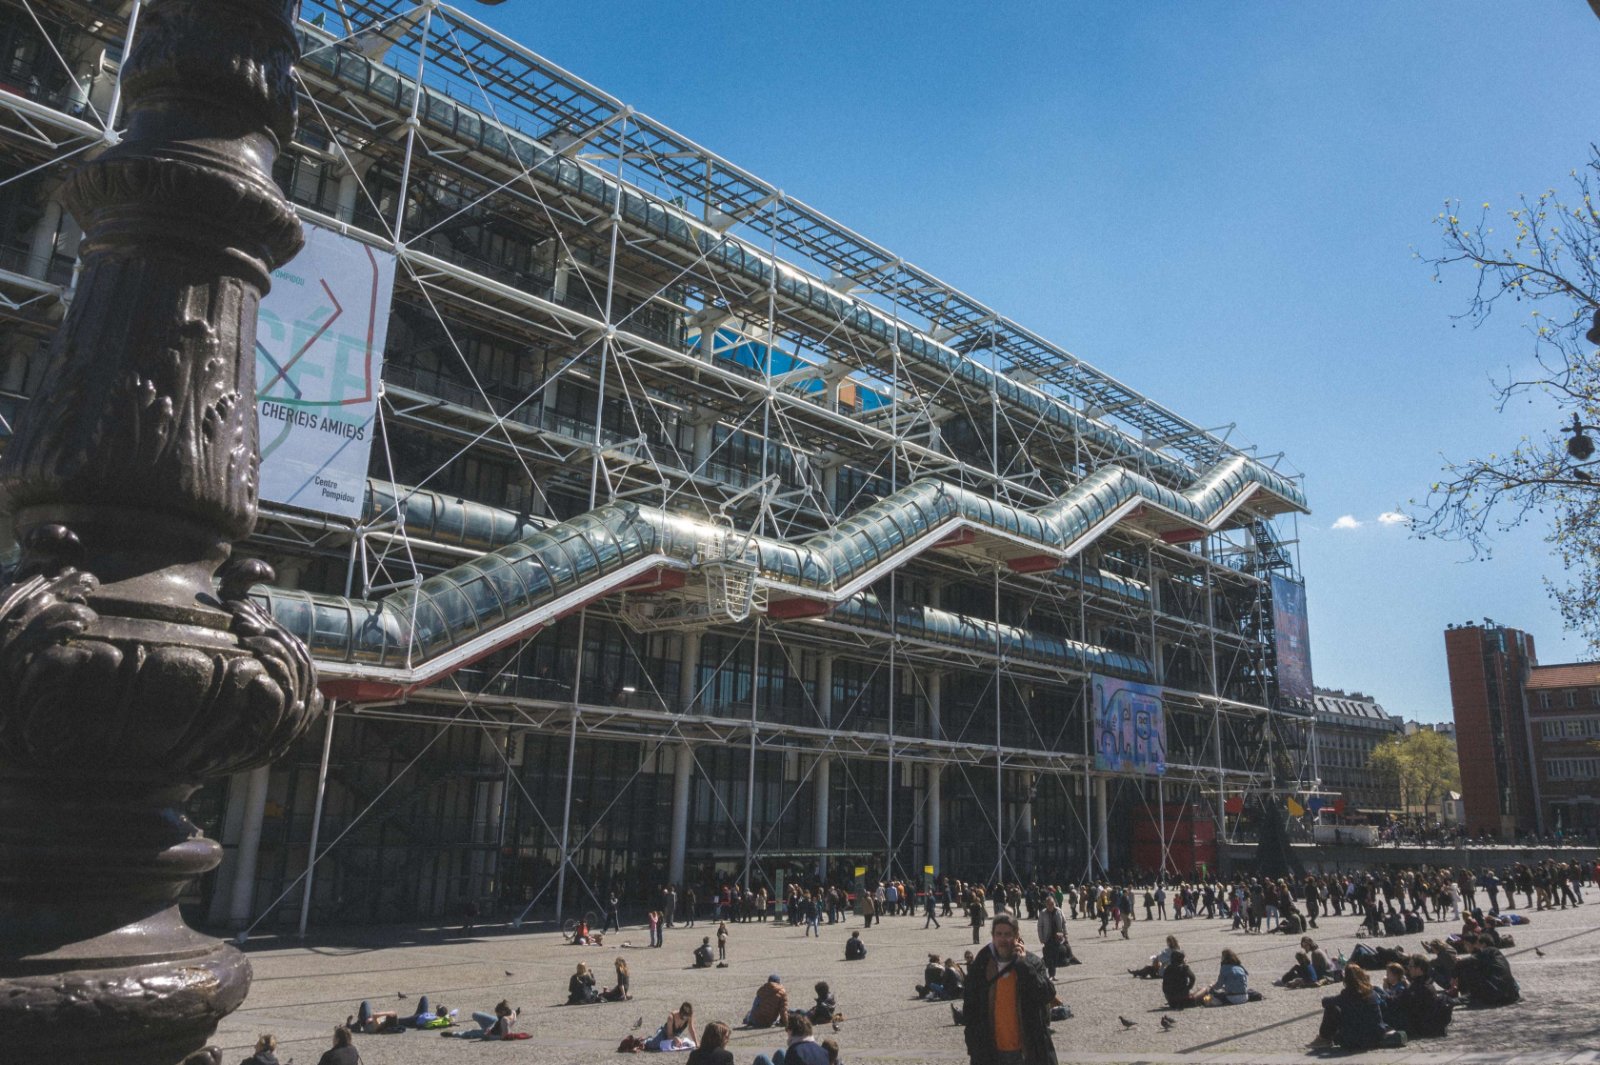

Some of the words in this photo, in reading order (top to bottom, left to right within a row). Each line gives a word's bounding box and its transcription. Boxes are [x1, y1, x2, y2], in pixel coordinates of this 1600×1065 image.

[262, 401, 318, 429] CHER(E)S
[320, 417, 365, 441] AMI(E)S
[314, 475, 338, 489] Centre
[321, 487, 355, 503] Pompidou
